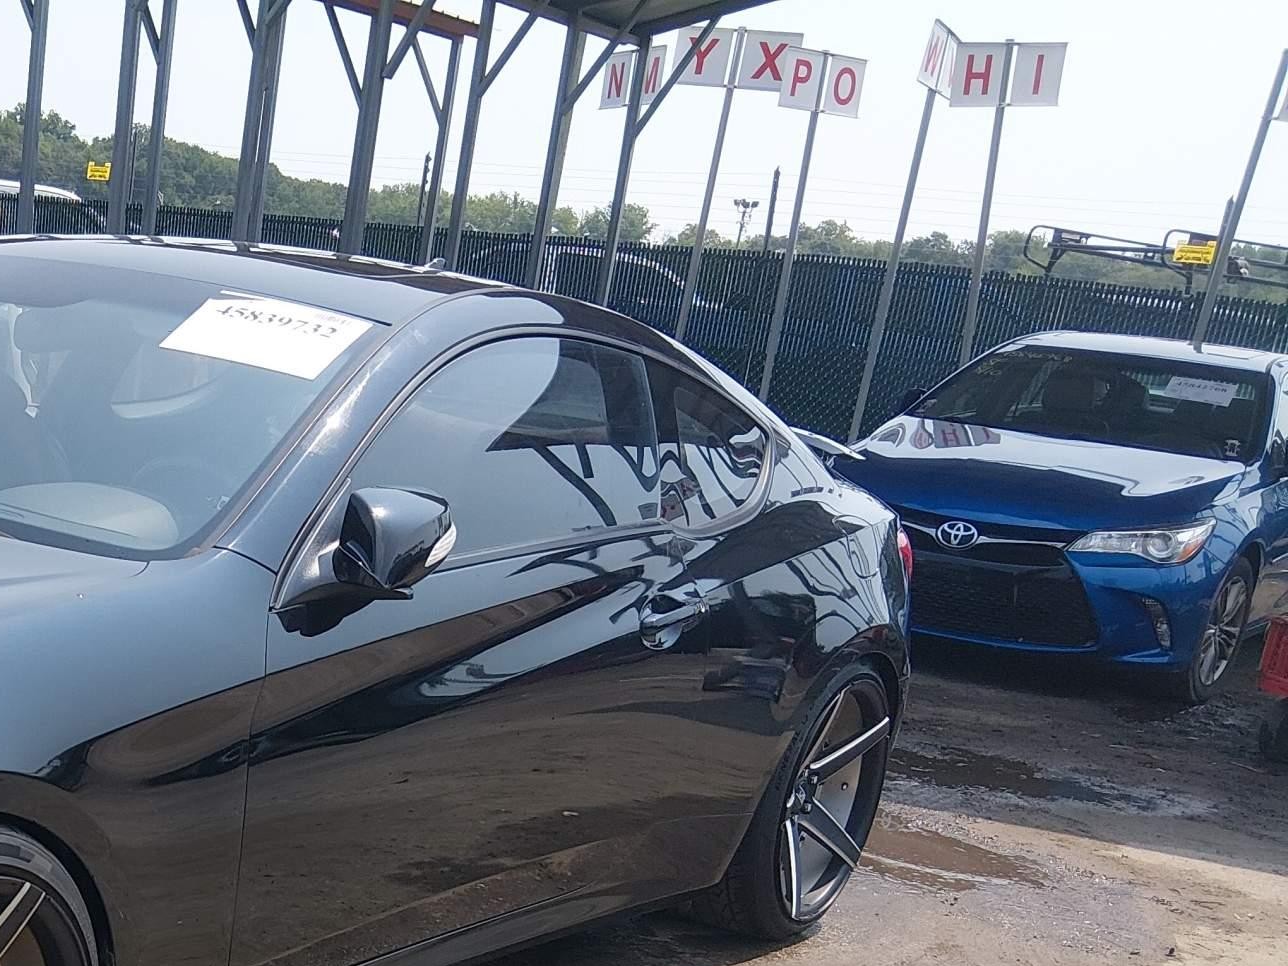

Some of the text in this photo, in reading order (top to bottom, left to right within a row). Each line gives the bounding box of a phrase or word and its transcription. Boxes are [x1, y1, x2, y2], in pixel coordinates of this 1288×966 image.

[689, 37, 789, 81] Y X
[790, 58, 812, 97] P
[963, 54, 993, 95] H
[1032, 54, 1044, 95] I
[607, 62, 625, 99] N
[216, 305, 337, 338] 45839732
